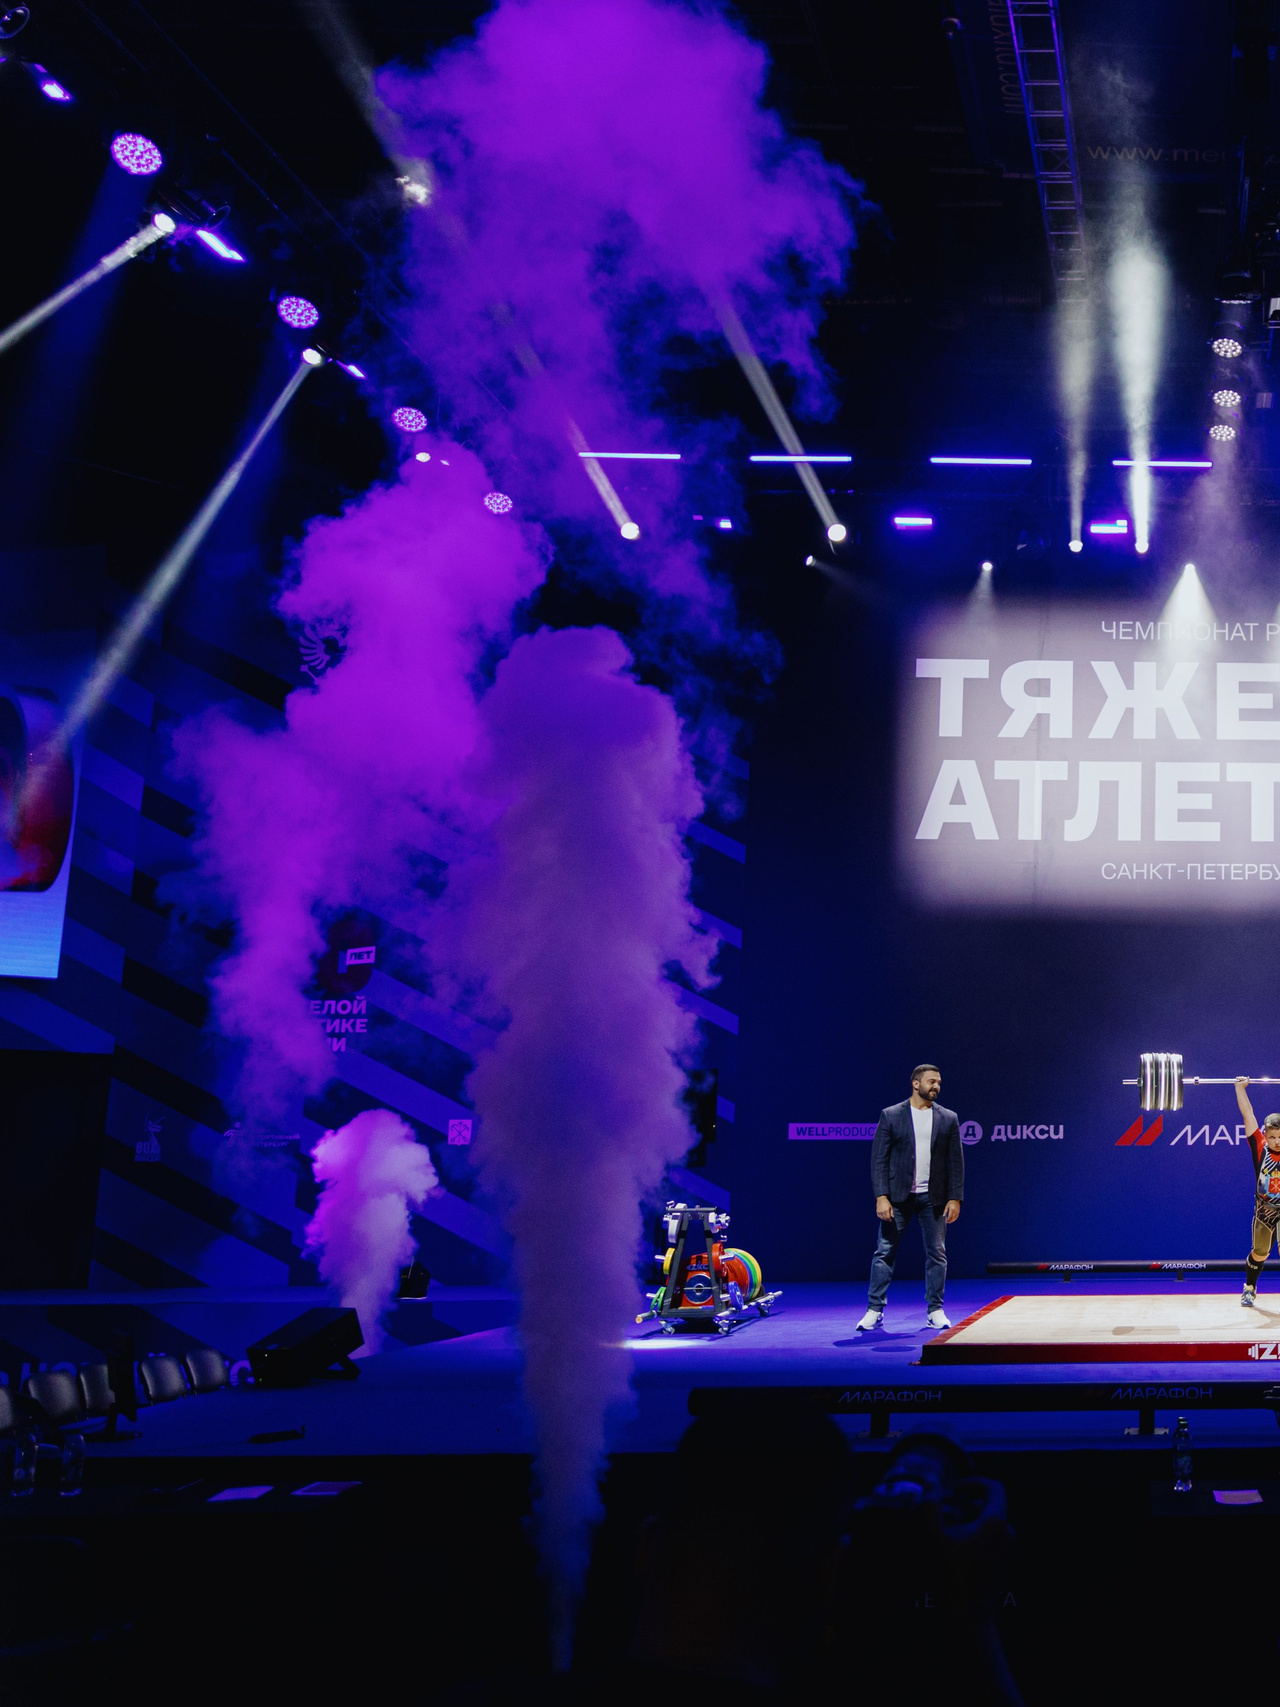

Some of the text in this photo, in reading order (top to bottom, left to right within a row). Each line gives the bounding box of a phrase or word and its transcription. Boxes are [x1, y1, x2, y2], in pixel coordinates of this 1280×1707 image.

[1101, 620, 1258, 642] ЧЕМПИОНАТ
[310, 996, 367, 1015] ЕЛОЙ
[1049, 1263, 1094, 1271] МАРАФОН
[837, 1390, 943, 1404] МАРАФОН
[1110, 1386, 1213, 1401] МАРАФОН
